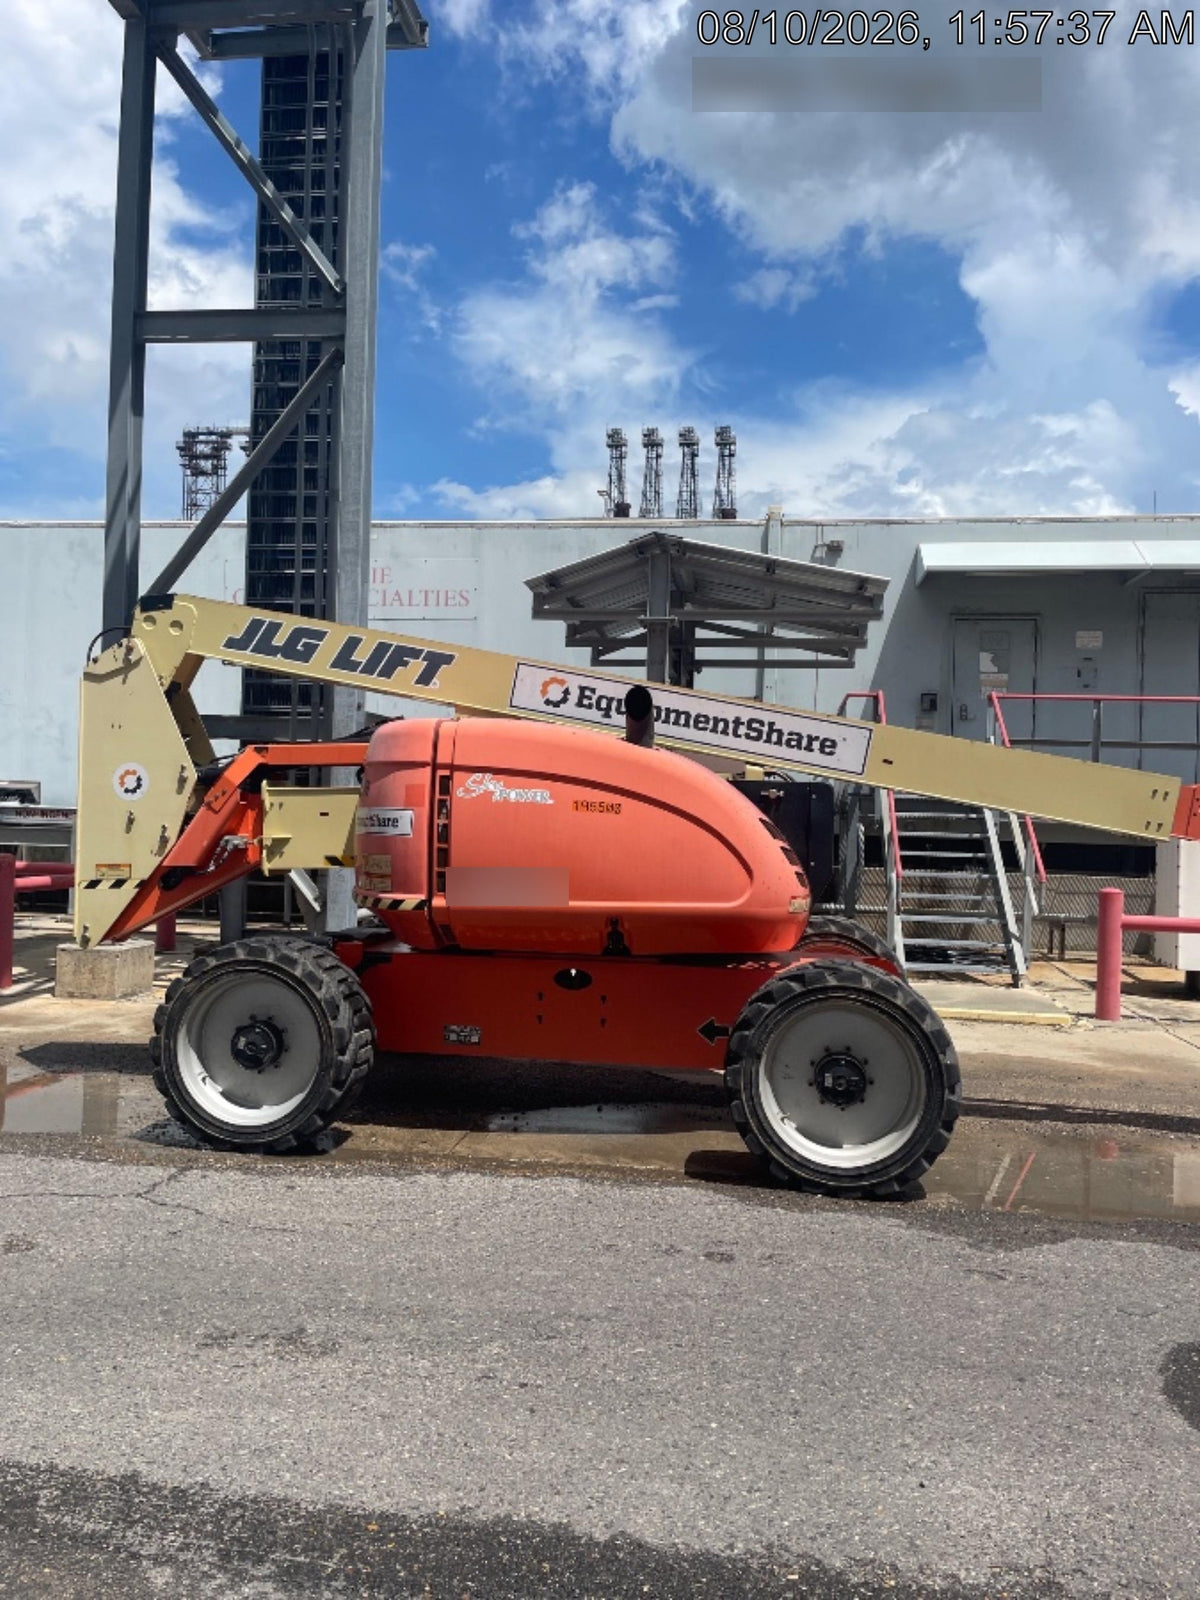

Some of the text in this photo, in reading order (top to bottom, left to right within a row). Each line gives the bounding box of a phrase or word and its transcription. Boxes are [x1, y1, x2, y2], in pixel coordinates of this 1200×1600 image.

[221, 617, 458, 687] JLG LIFT
[574, 685, 838, 757] EqumentShare
